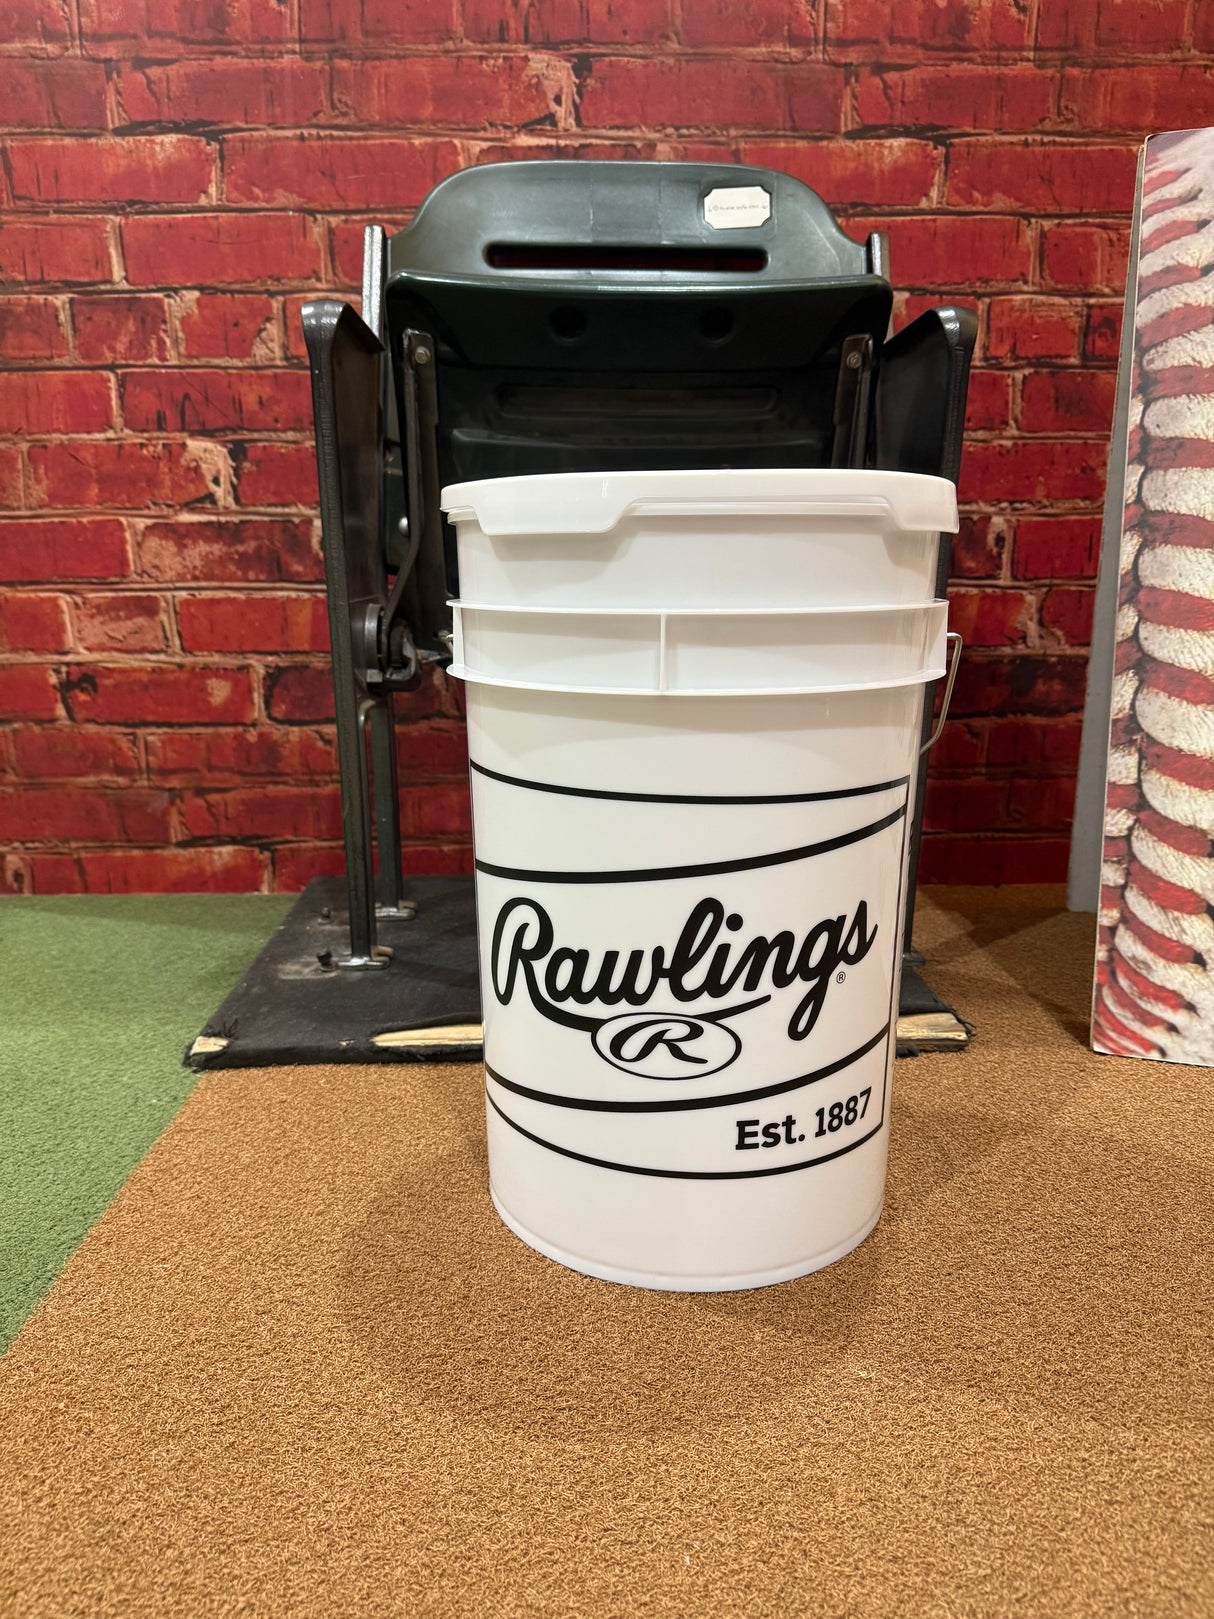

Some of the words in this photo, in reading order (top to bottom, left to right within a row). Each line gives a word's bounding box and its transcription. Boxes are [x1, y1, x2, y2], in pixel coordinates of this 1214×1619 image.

[492, 897, 878, 1041] Rawlings
[609, 1018, 709, 1065] R
[736, 1114, 805, 1151] Est.
[815, 1086, 872, 1138] 1887
